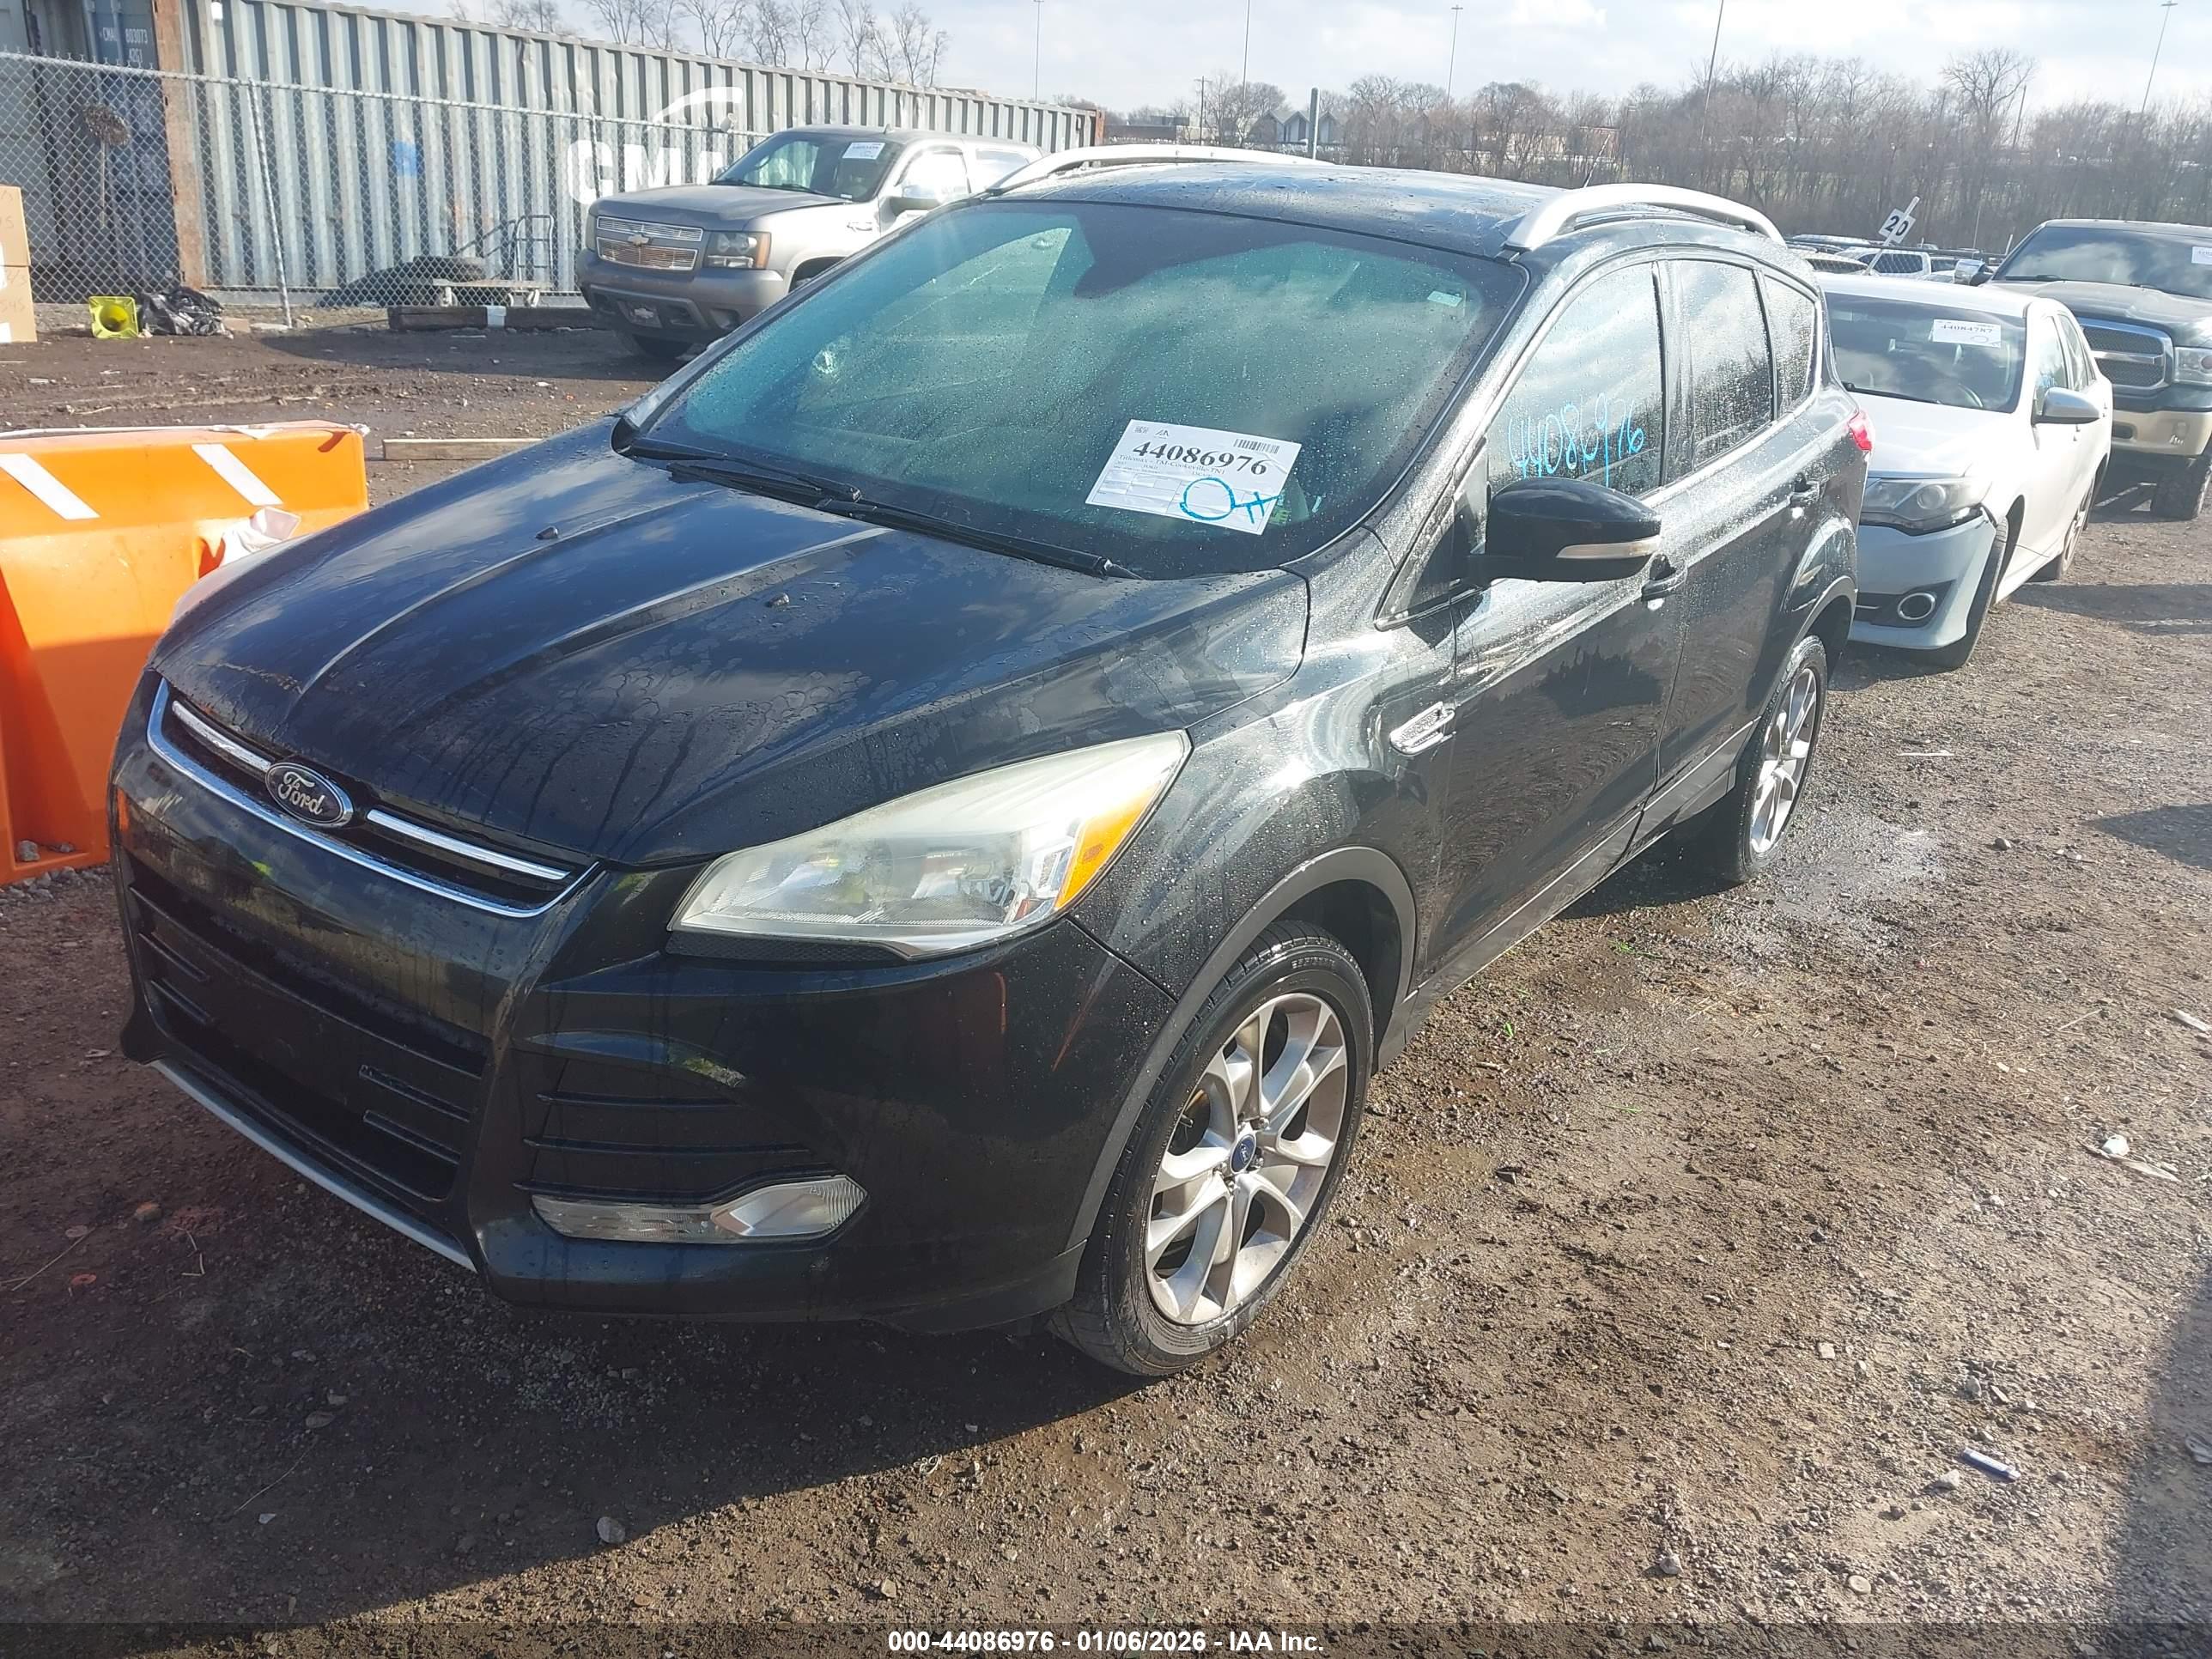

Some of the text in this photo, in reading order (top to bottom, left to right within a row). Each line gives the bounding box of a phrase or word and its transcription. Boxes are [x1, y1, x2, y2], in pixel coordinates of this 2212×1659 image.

[1885, 215, 1909, 236] 20
[1133, 441, 1271, 475] 44086976
[277, 771, 325, 815] Ford
